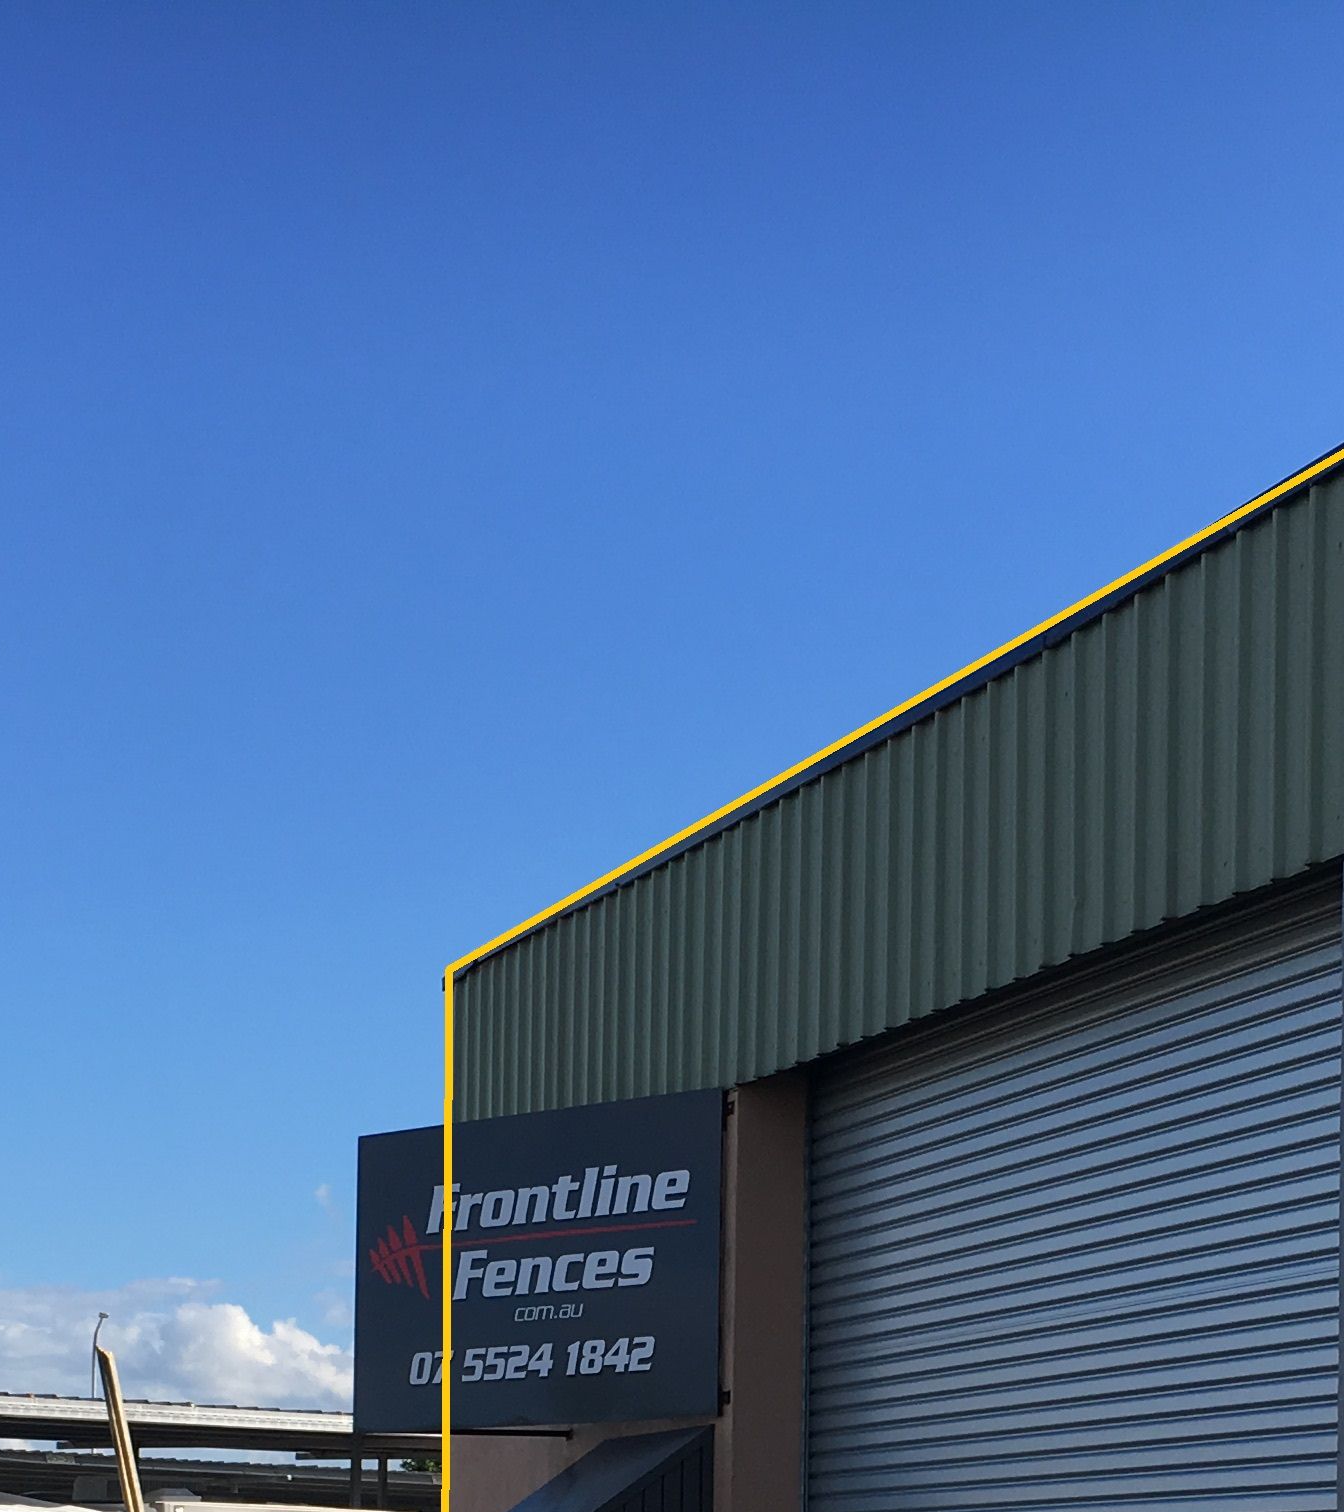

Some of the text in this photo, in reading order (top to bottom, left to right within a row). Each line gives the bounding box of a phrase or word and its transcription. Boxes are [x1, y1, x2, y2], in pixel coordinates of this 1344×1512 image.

[426, 1165, 690, 1234] Frontline
[452, 1247, 655, 1301] Fences
[514, 1303, 584, 1322] com.au
[409, 1336, 655, 1385] 07 5524 1842
